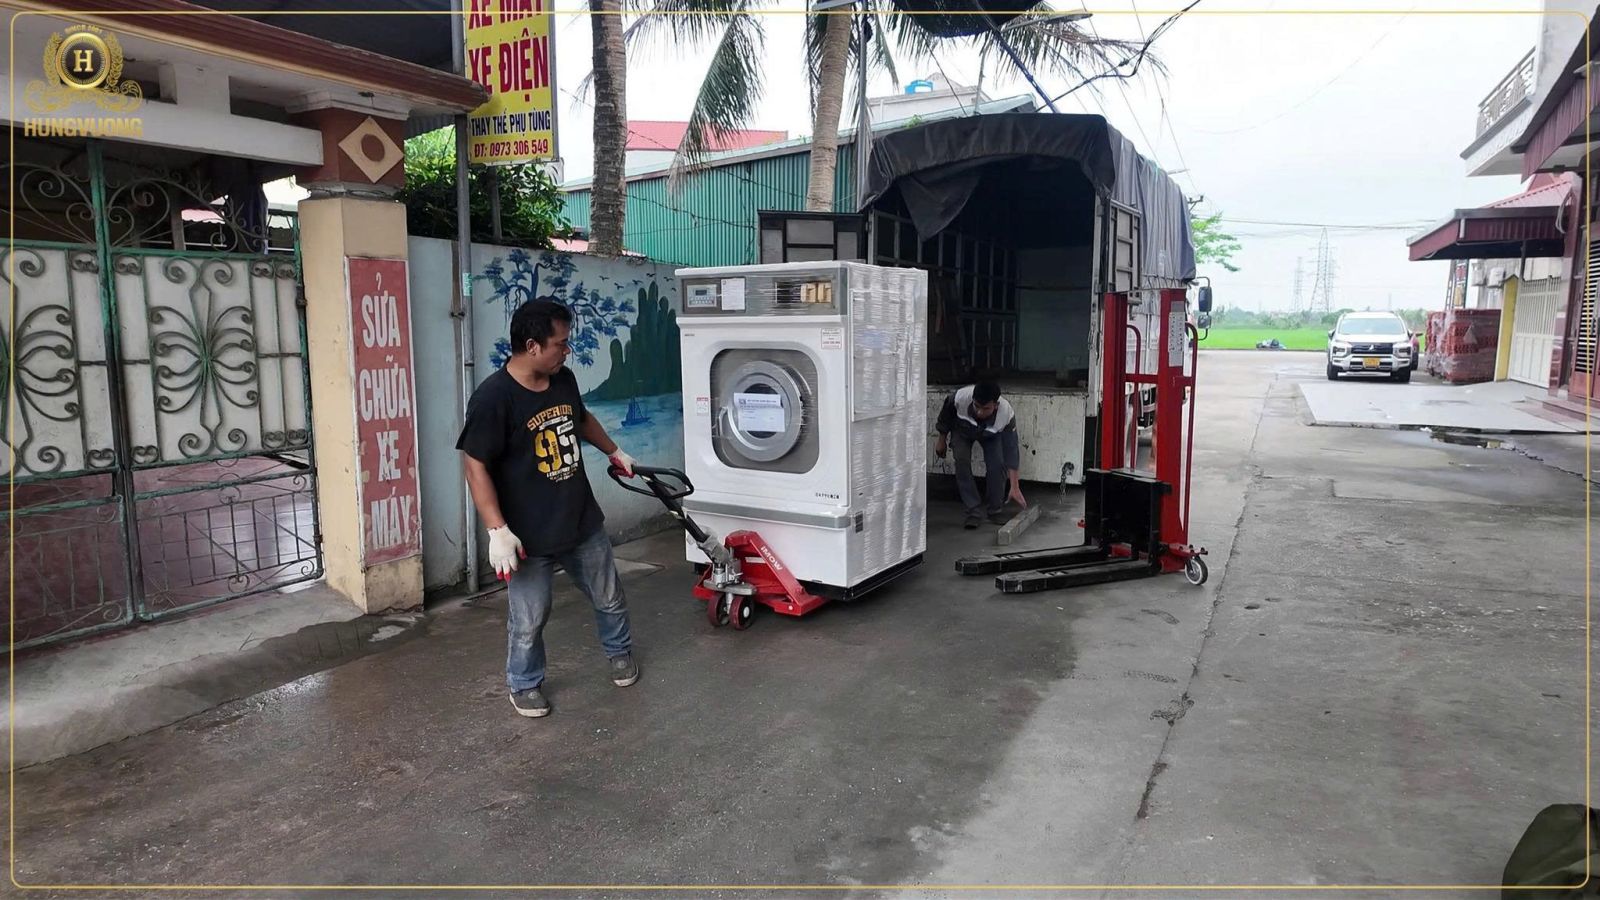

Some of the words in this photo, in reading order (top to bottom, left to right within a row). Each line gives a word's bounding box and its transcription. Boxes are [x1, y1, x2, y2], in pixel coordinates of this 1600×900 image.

[468, 46, 493, 97] XE
[499, 28, 549, 102] ĐIỆN
[471, 116, 491, 136] THAY
[510, 113, 526, 136] PHỤ
[528, 107, 551, 131] TÙNG
[490, 141, 511, 156] 0973
[513, 140, 529, 155] 306
[531, 138, 549, 154] 549
[361, 272, 400, 348] SỬA
[359, 354, 411, 422] CHỮA
[526, 404, 573, 431] SUPERIOR
[376, 430, 401, 482] XE
[370, 486, 411, 549] MÁY
[760, 545, 784, 571] IMOW
